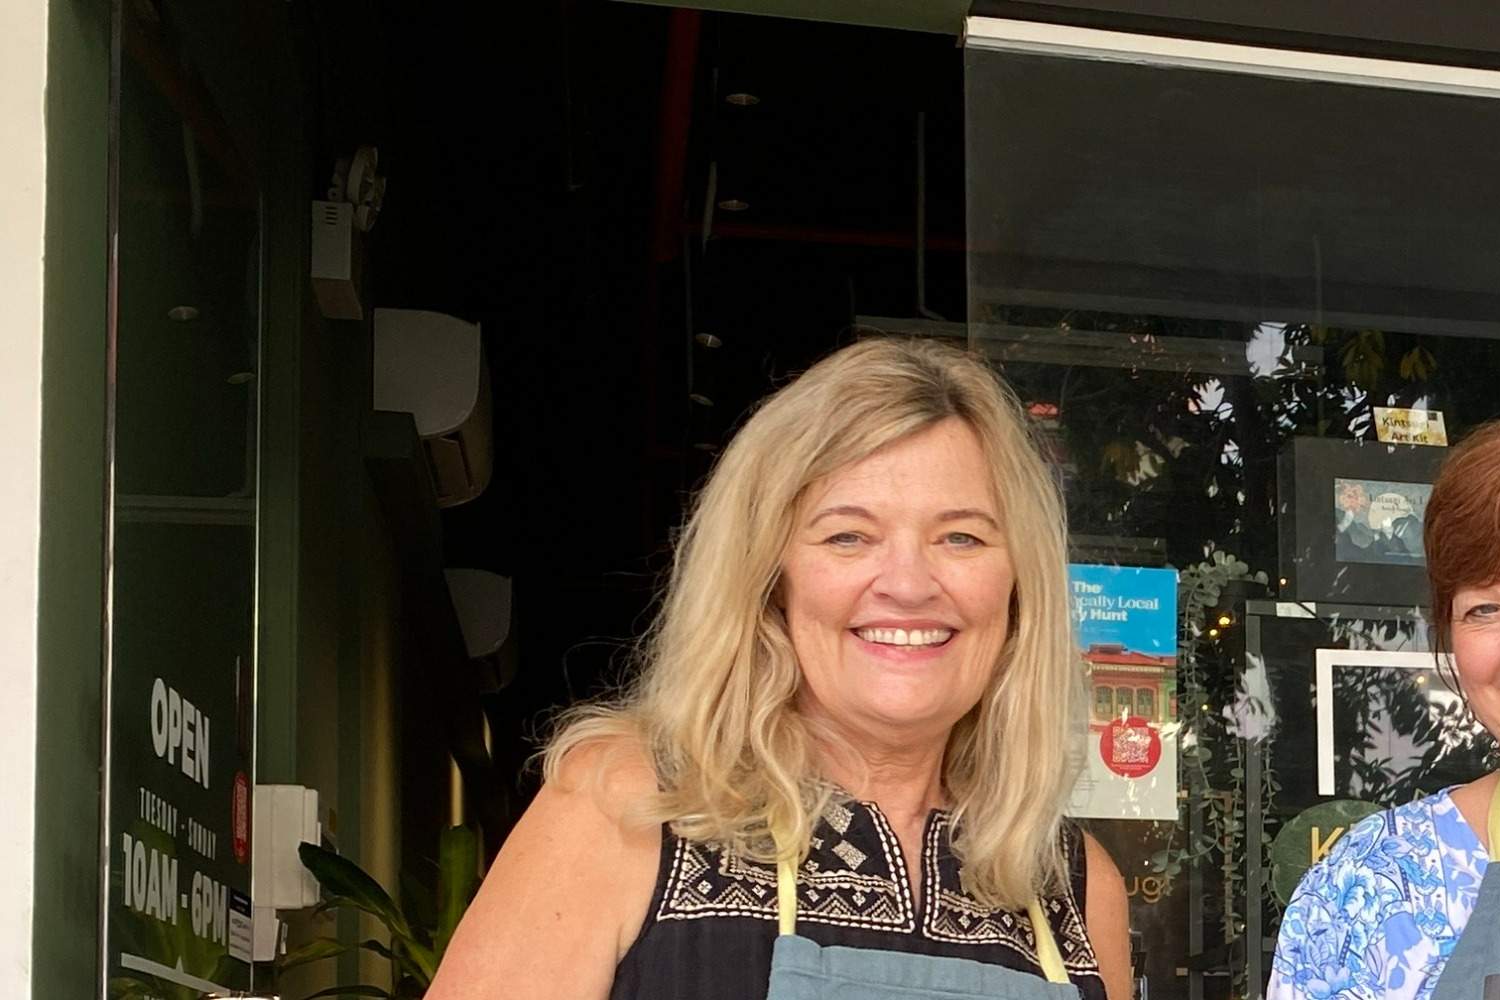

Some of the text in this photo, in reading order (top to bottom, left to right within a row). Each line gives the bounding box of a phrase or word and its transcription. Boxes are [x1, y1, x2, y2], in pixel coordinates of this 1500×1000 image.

[1090, 608, 1128, 621] Hunt
[1118, 596, 1159, 610] Local
[151, 677, 210, 790] OPEN
[140, 787, 178, 838] TUESDAY
[123, 832, 178, 926] 10AM
[191, 870, 227, 947] 6PM
